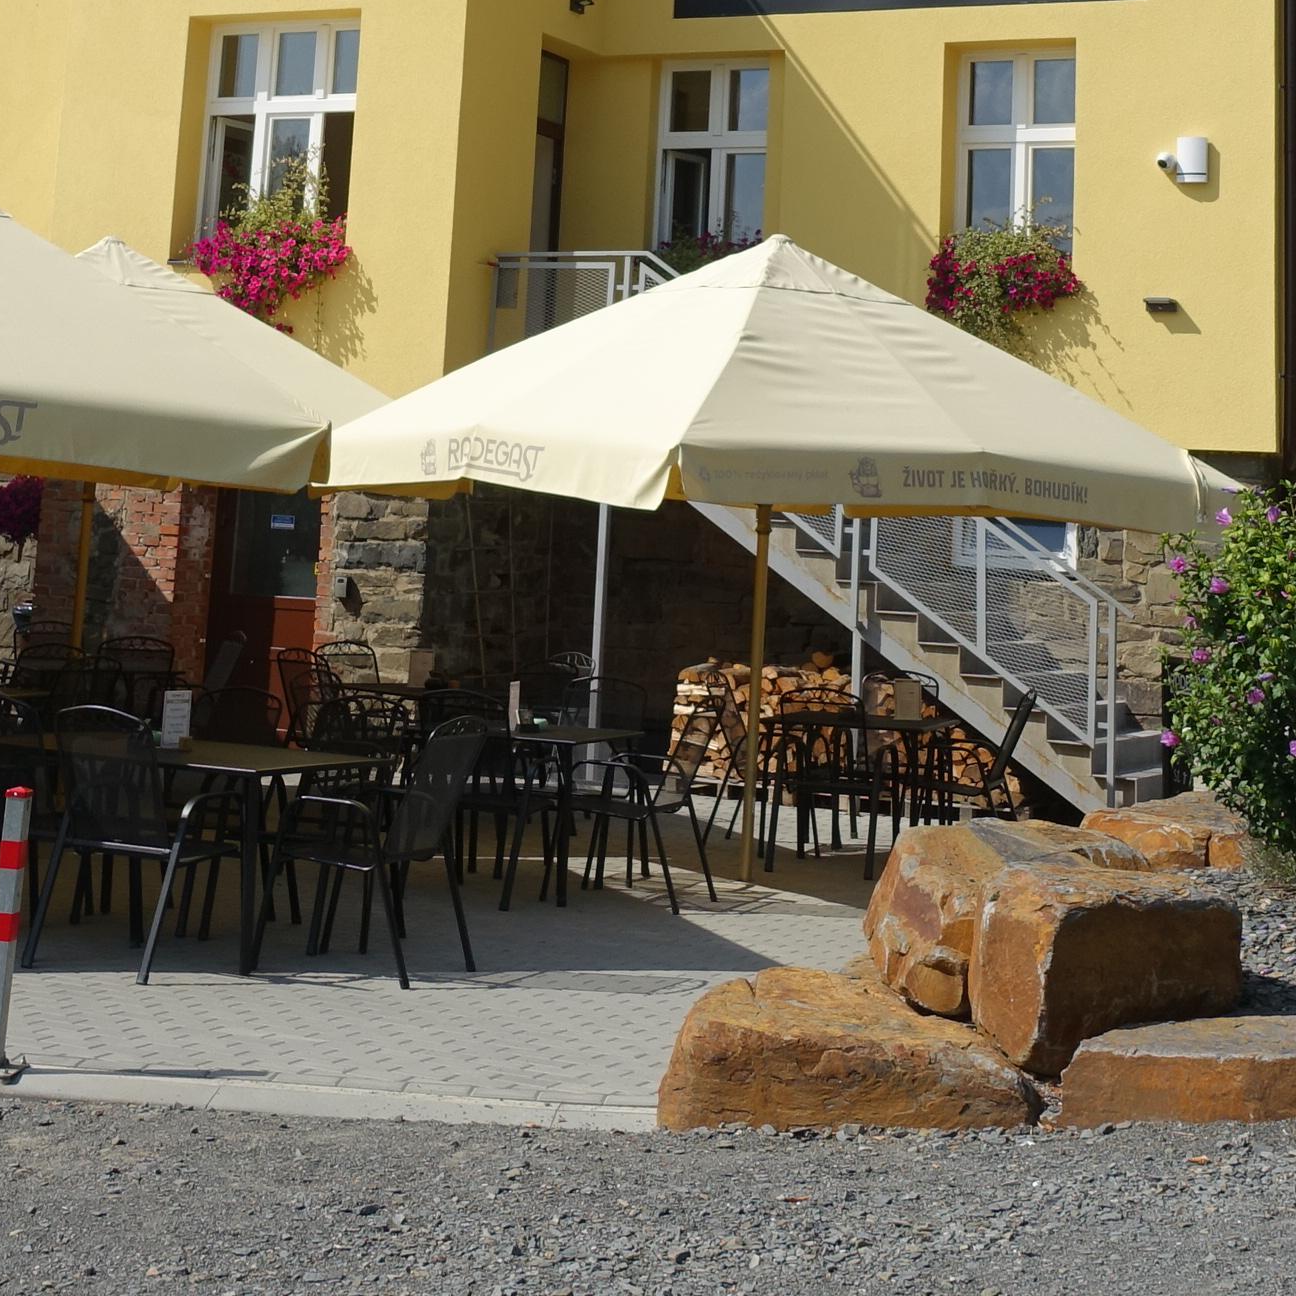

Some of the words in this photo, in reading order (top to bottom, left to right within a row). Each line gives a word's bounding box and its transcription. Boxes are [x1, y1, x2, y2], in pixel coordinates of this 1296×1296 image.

[447, 436, 545, 483] RADEGAST
[902, 465, 945, 488] ŽIVOT
[951, 471, 966, 488] JE
[970, 469, 1020, 494] HOŘKÝ.
[1024, 478, 1088, 504] BOHUDÍK!
